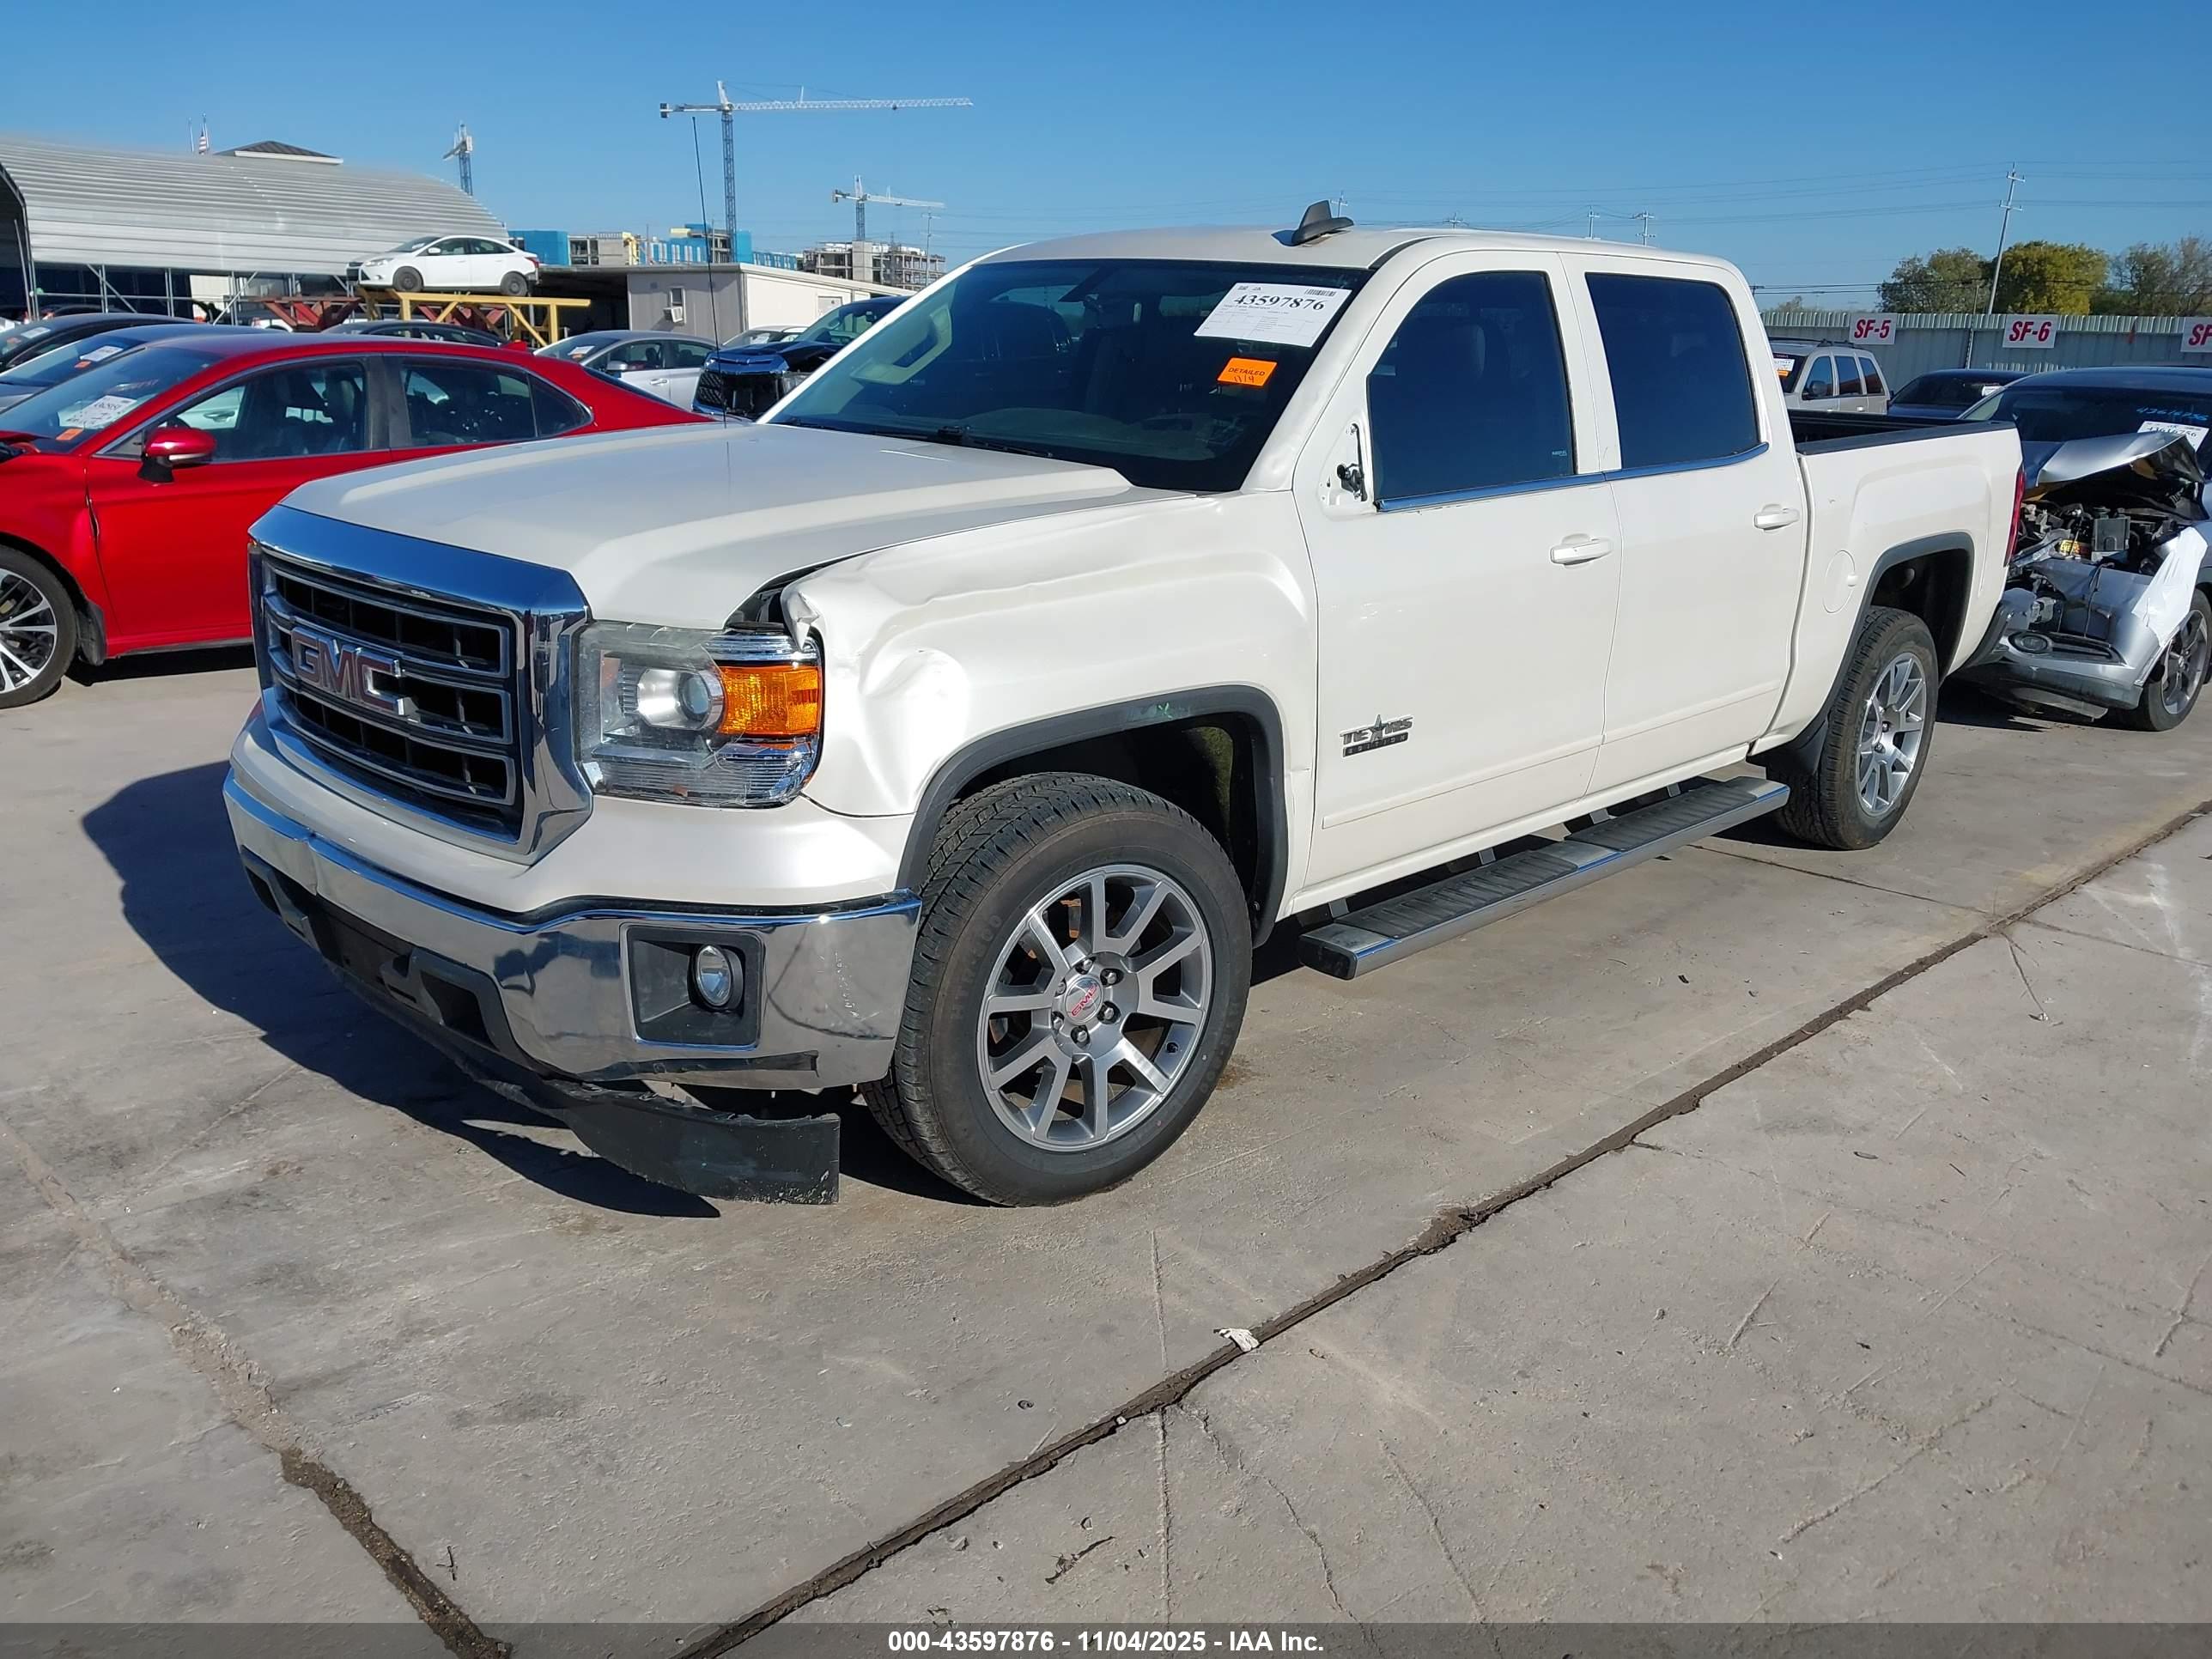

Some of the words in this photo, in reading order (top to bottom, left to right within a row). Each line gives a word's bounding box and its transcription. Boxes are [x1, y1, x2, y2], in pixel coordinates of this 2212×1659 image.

[1234, 295, 1325, 310] 43597876
[1854, 319, 1891, 339] SF-5
[2008, 320, 2052, 342] SF-6
[1228, 367, 1266, 376] DETAILED
[291, 627, 405, 716] GMC
[1072, 983, 1098, 1016] GMC
